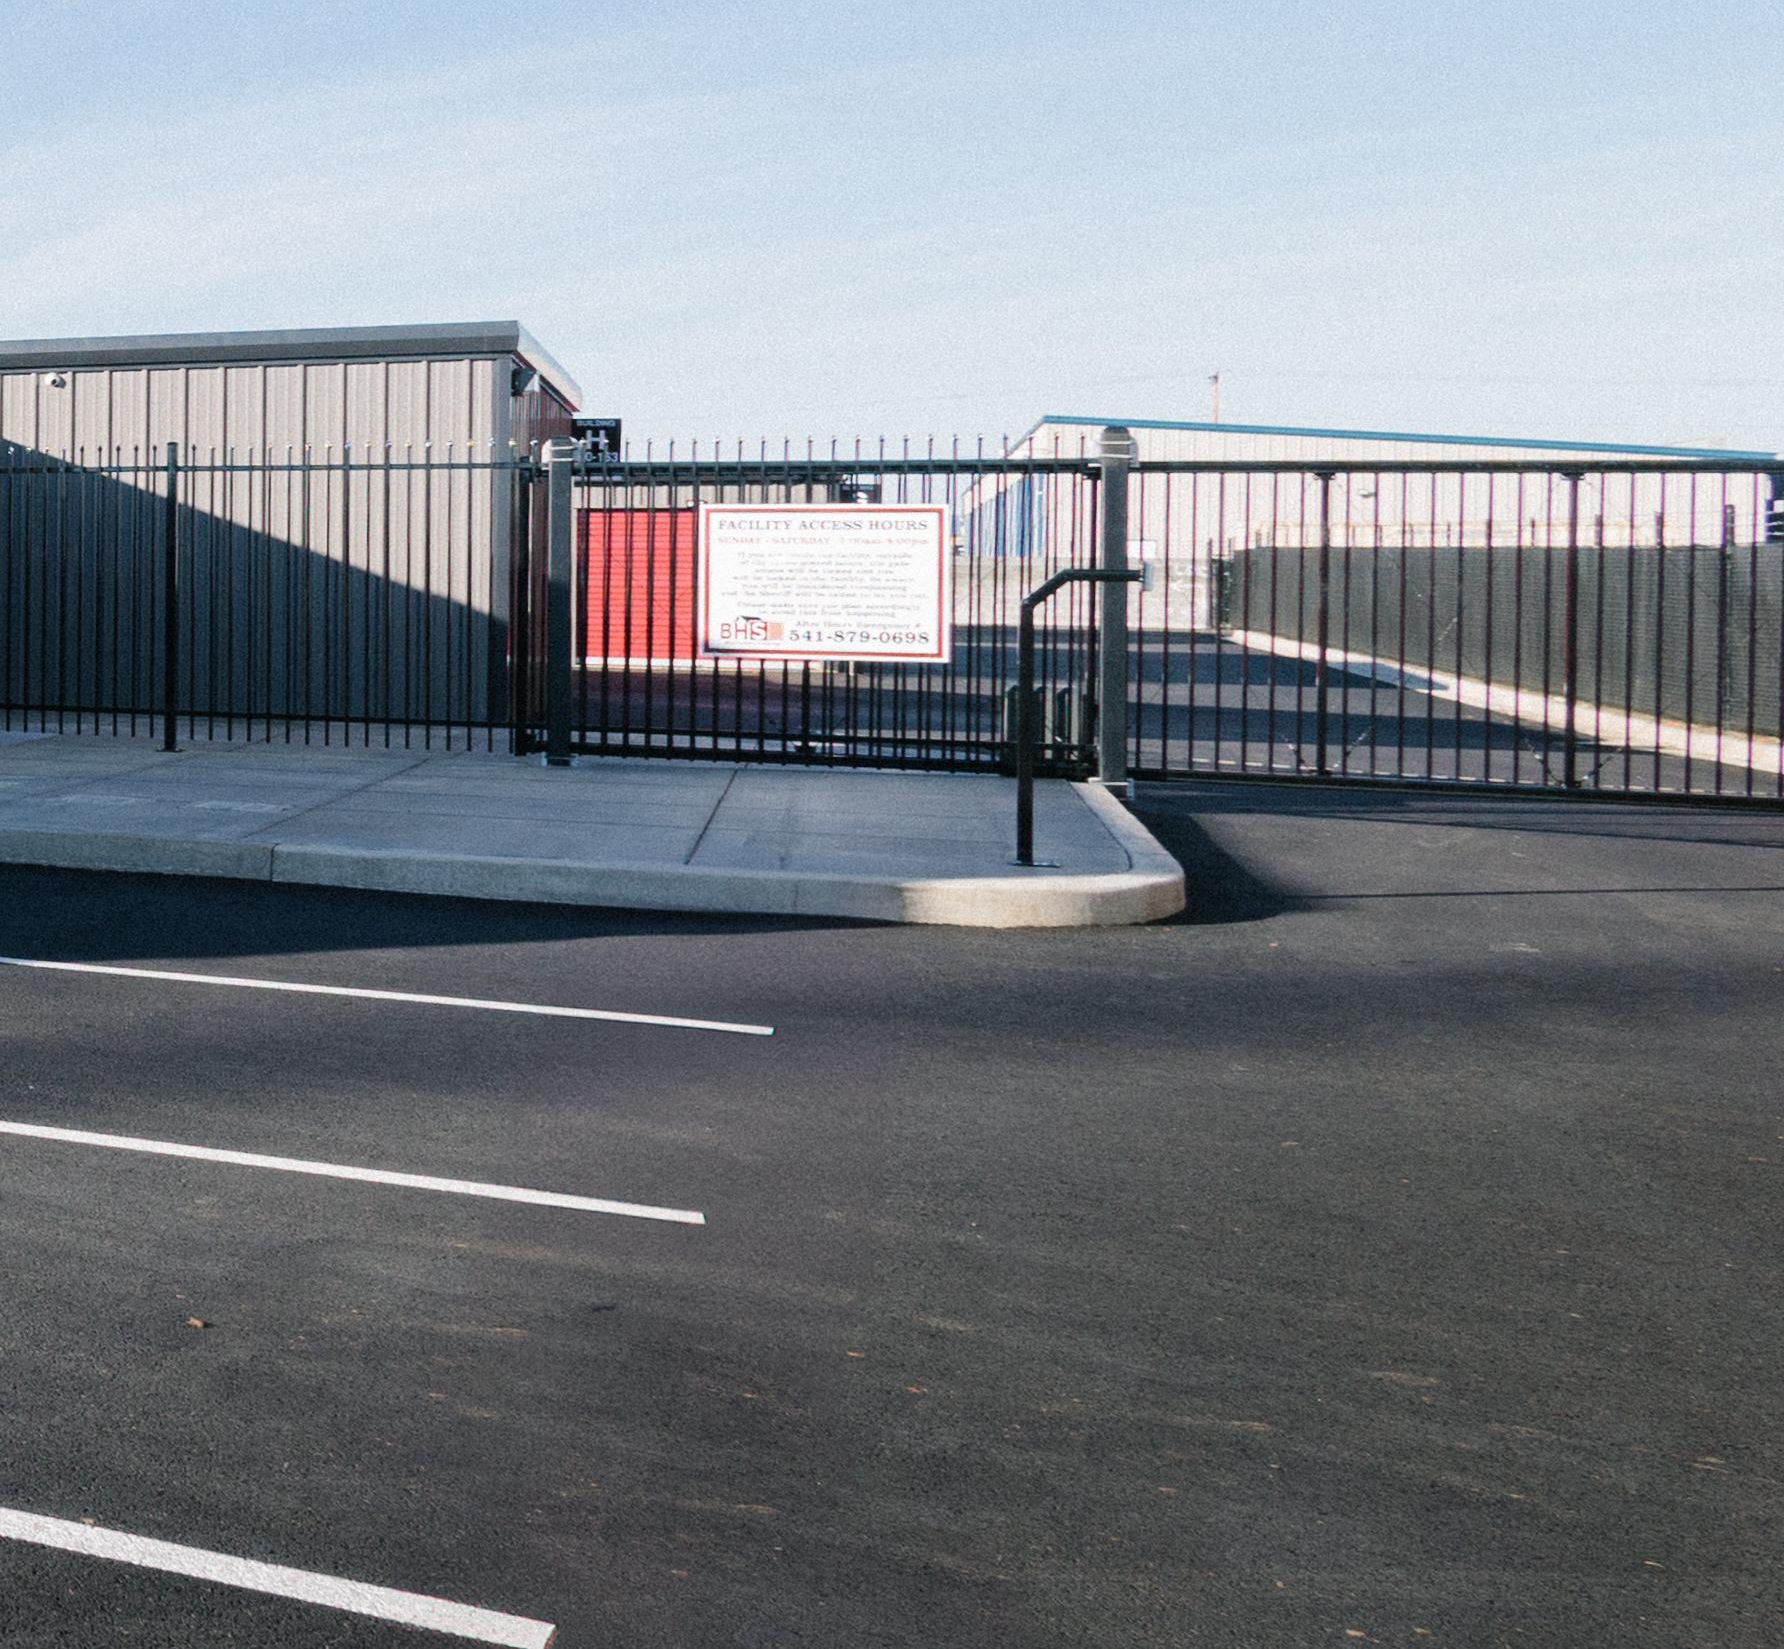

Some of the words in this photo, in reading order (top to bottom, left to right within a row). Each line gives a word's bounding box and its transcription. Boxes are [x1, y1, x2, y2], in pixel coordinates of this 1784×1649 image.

[585, 429, 606, 450] H
[718, 519, 792, 531] FACILITY
[799, 520, 863, 531] ACCESS
[868, 520, 929, 531] HOURS
[720, 619, 768, 641] BHS
[788, 629, 930, 644] 541-879-0698
